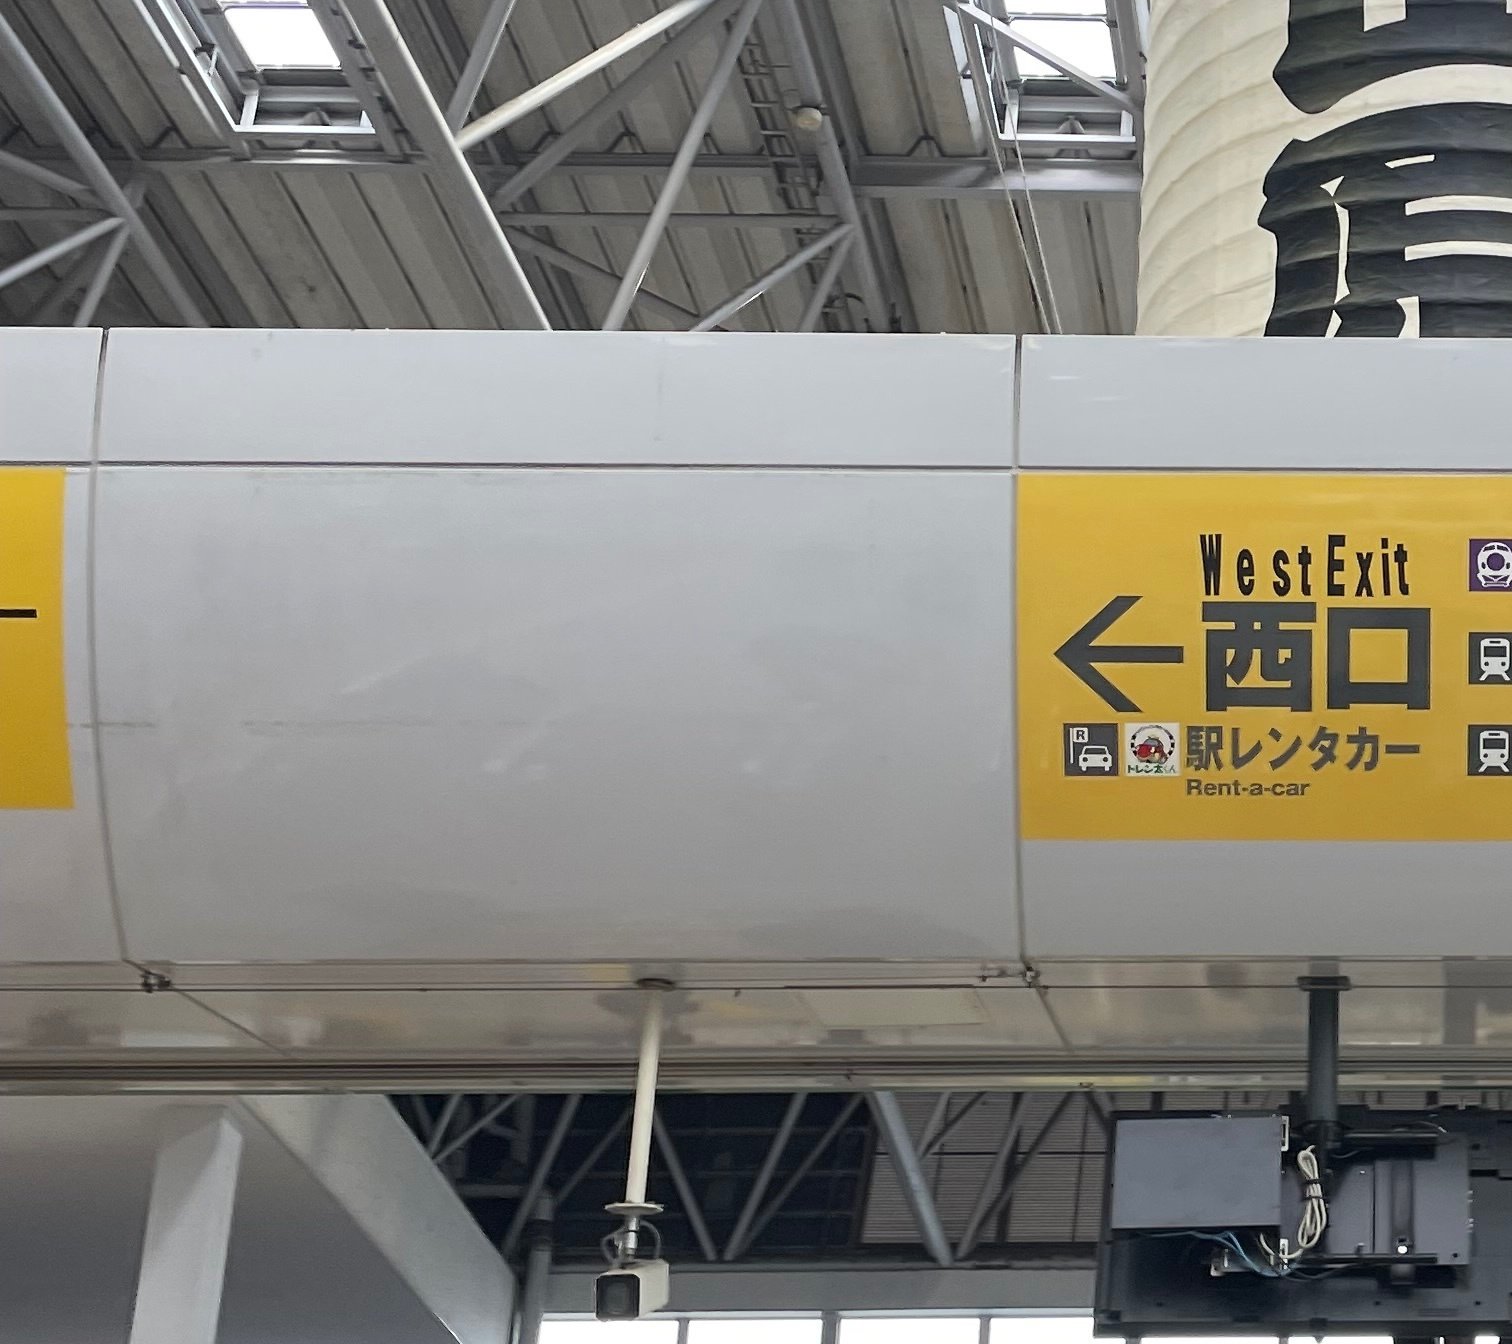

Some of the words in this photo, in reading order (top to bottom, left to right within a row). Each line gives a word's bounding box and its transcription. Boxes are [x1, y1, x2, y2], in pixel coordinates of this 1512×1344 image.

[1201, 601, 1432, 713] 西口
[1186, 725, 1420, 771] 駅レンタカー
[1186, 779, 1310, 797] Rent-a-car
